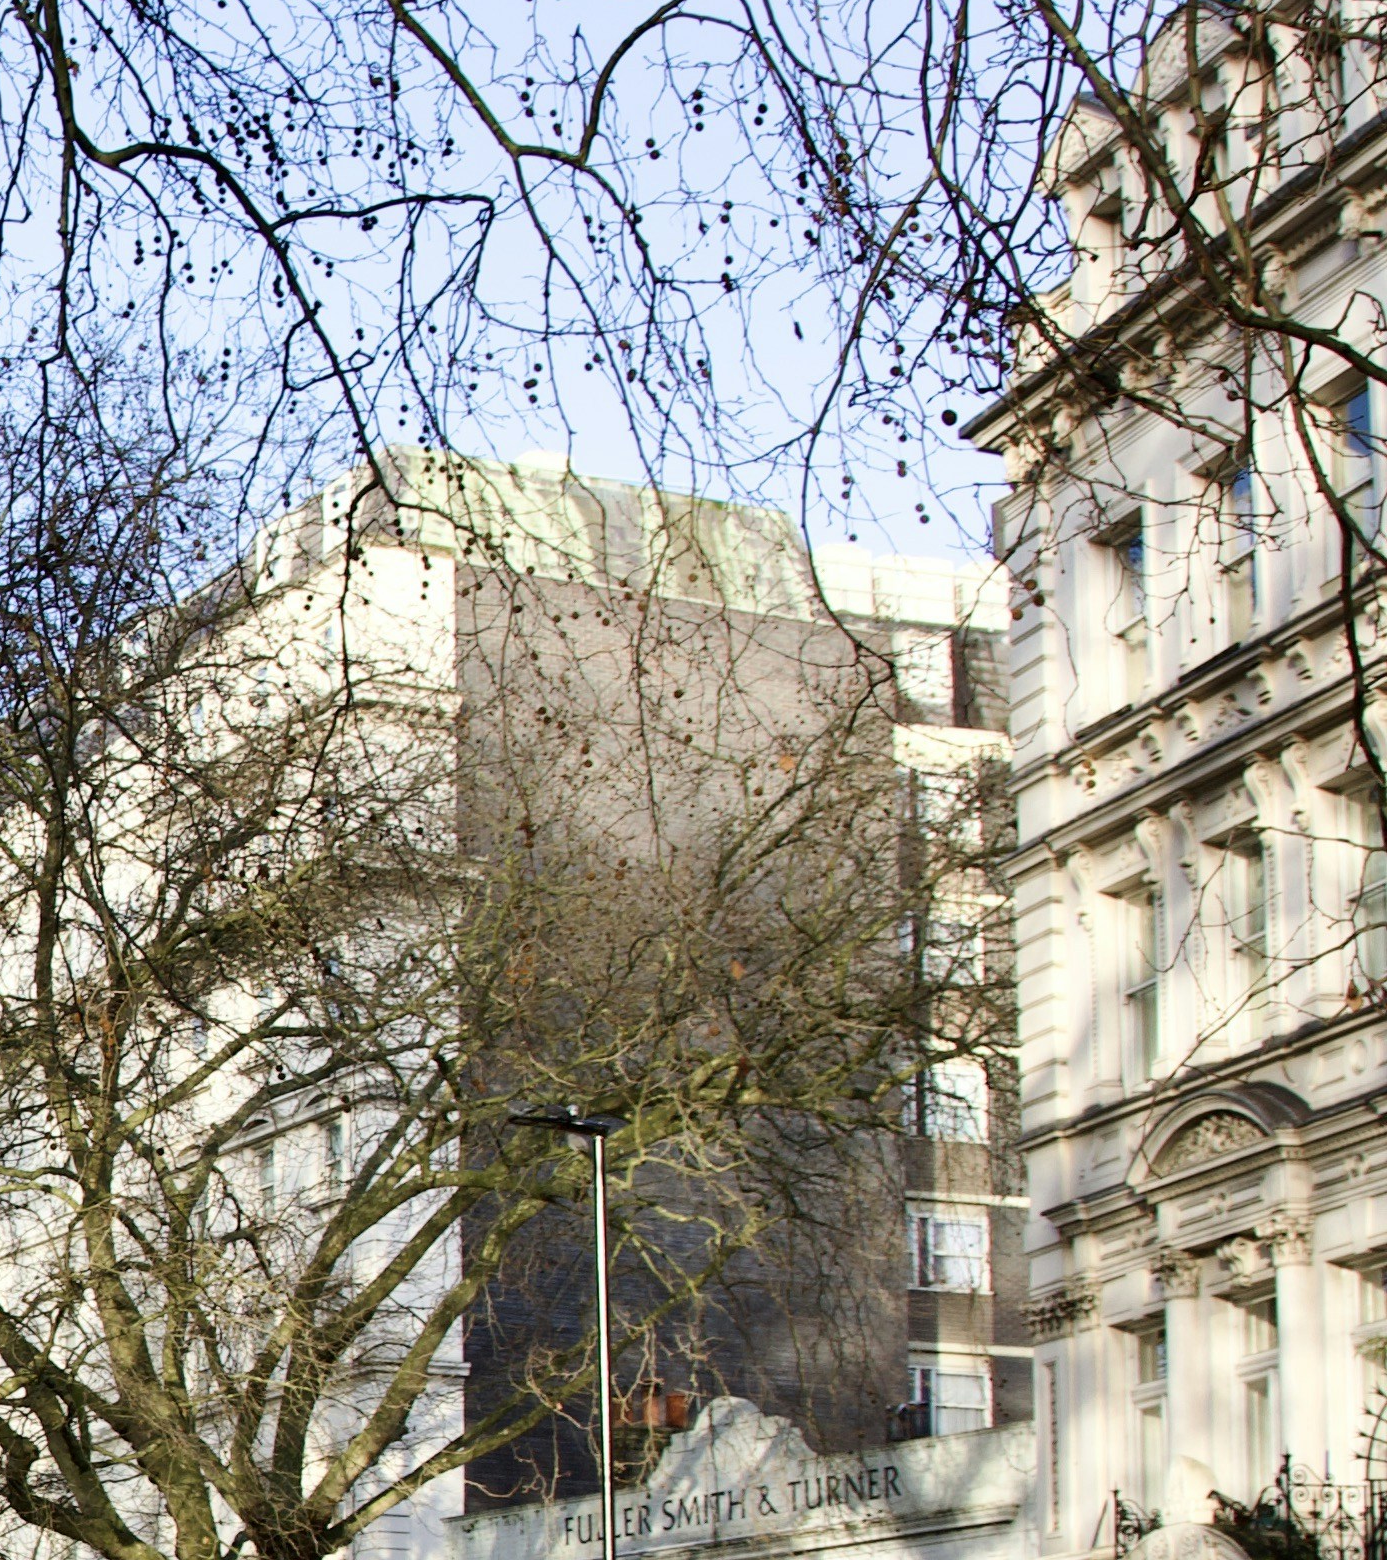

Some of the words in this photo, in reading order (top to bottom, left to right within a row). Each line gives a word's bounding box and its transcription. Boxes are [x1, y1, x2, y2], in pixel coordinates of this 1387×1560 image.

[662, 1490, 747, 1532] SMITH
[757, 1485, 779, 1515] &
[787, 1465, 903, 1512] TURNER
